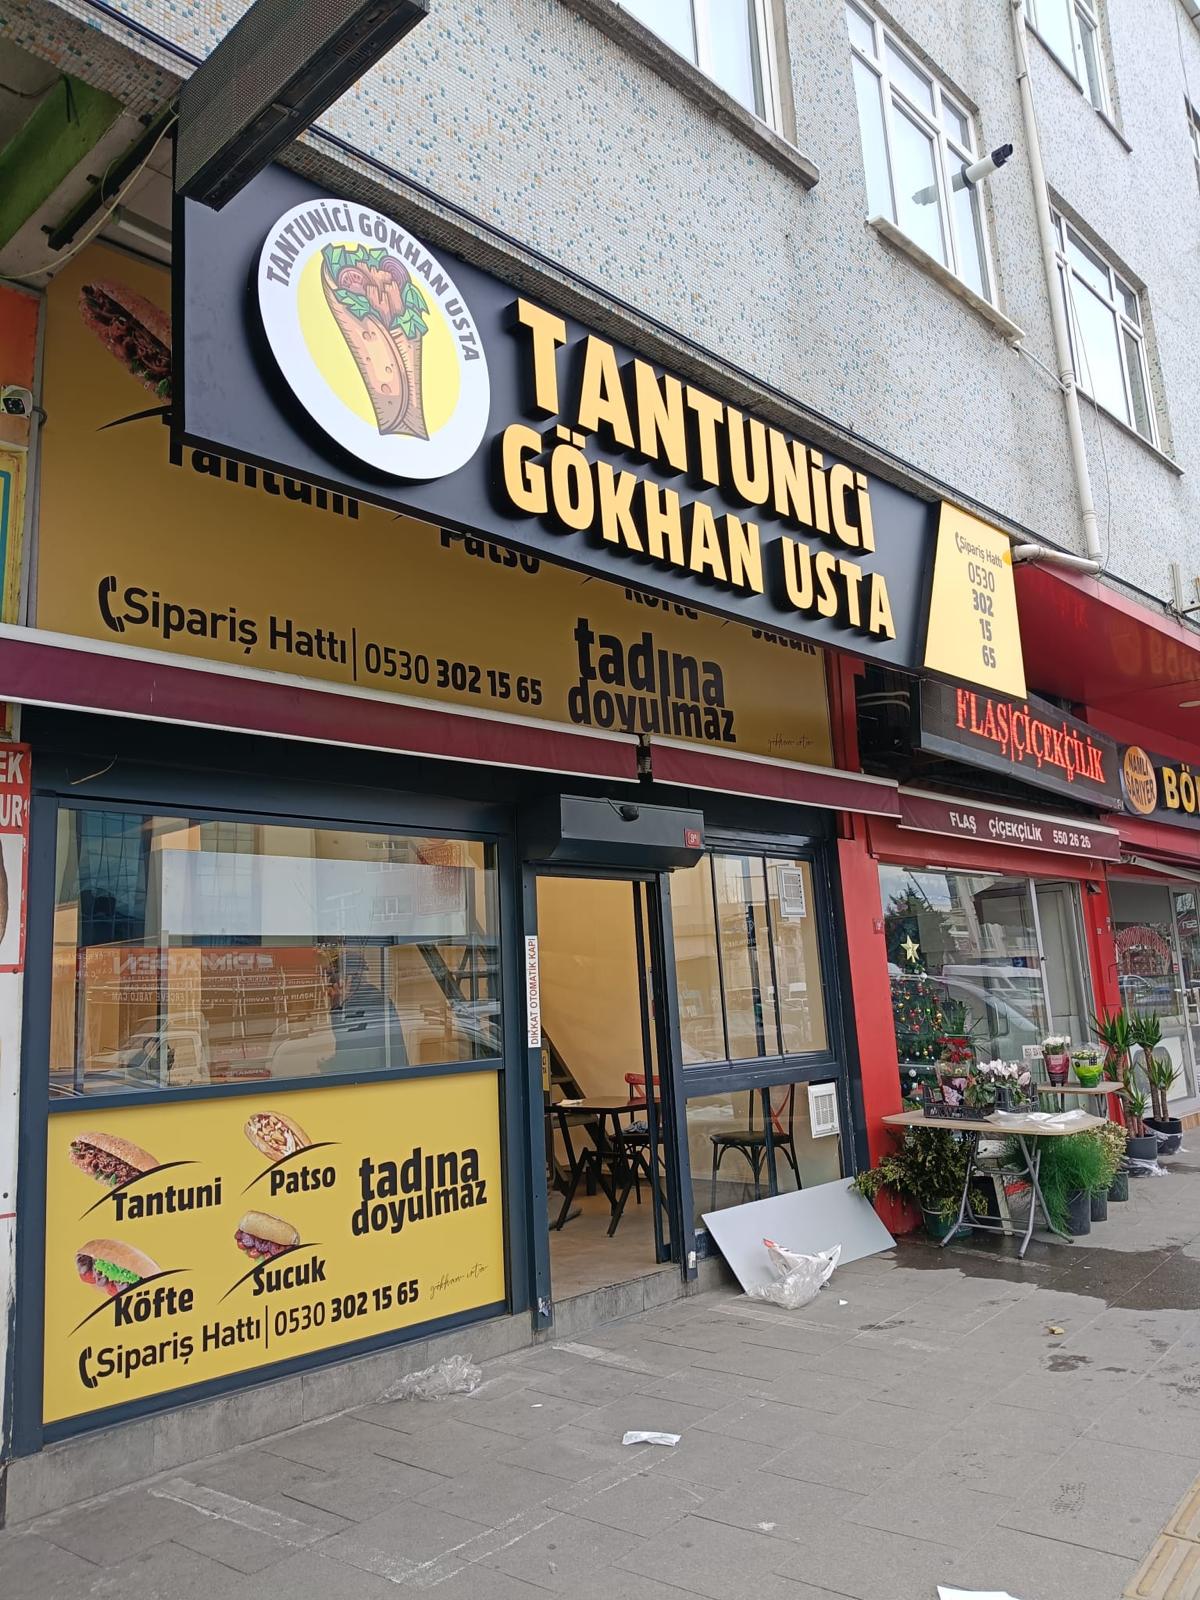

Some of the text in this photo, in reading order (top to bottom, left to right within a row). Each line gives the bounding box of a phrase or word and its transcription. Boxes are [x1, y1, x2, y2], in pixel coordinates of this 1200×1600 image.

[266, 202, 480, 361] TANTUNİCİ GÖKHAN USTA
[503, 423, 896, 640] GÖKHAN USTA
[959, 535, 985, 563] Sipariş
[968, 562, 995, 593] 0530
[972, 588, 994, 617] 302
[124, 586, 542, 706] Sipariş Hattı 0530 302 15 65
[574, 617, 725, 708] tadına
[979, 618, 992, 642] 15
[982, 645, 996, 669] 65
[568, 676, 737, 743] doyulmaz
[955, 688, 1009, 755] FLAŞ
[1162, 763, 1200, 813] BÖ
[949, 811, 1091, 849] FLAŞ ÇİÇEKÇİLİK 550 26 26
[527, 938, 540, 1045] DİKKAT OTOMATİK KAPI
[112, 1147, 480, 1222] Tantuni Patso tadına
[351, 1176, 488, 1236] doyulmaz
[114, 1256, 327, 1327] Köfte Sucuk
[96, 1278, 420, 1378] Sipariş Hattı 0530 302 15 65
